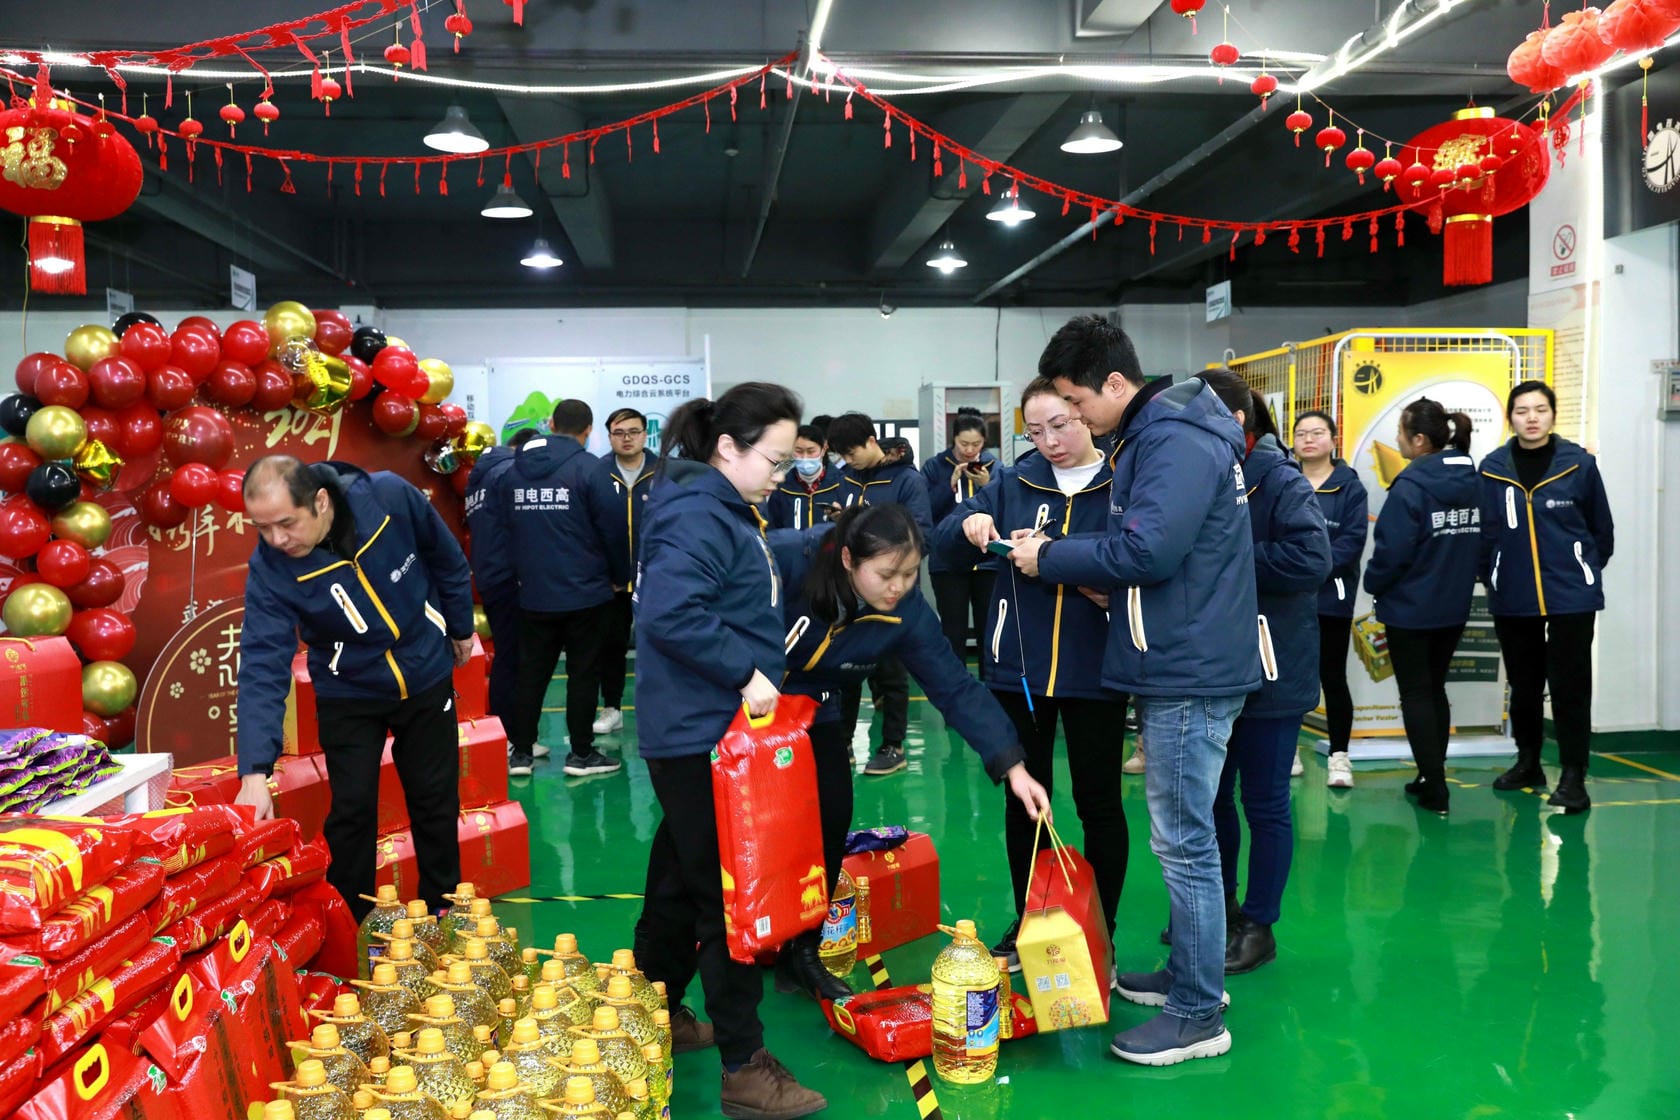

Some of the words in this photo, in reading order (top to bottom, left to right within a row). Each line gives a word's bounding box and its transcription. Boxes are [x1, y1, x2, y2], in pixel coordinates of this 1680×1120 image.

[622, 374, 691, 386] GDQS-GCS
[263, 407, 343, 462] 2021
[514, 487, 570, 503] 国电西高
